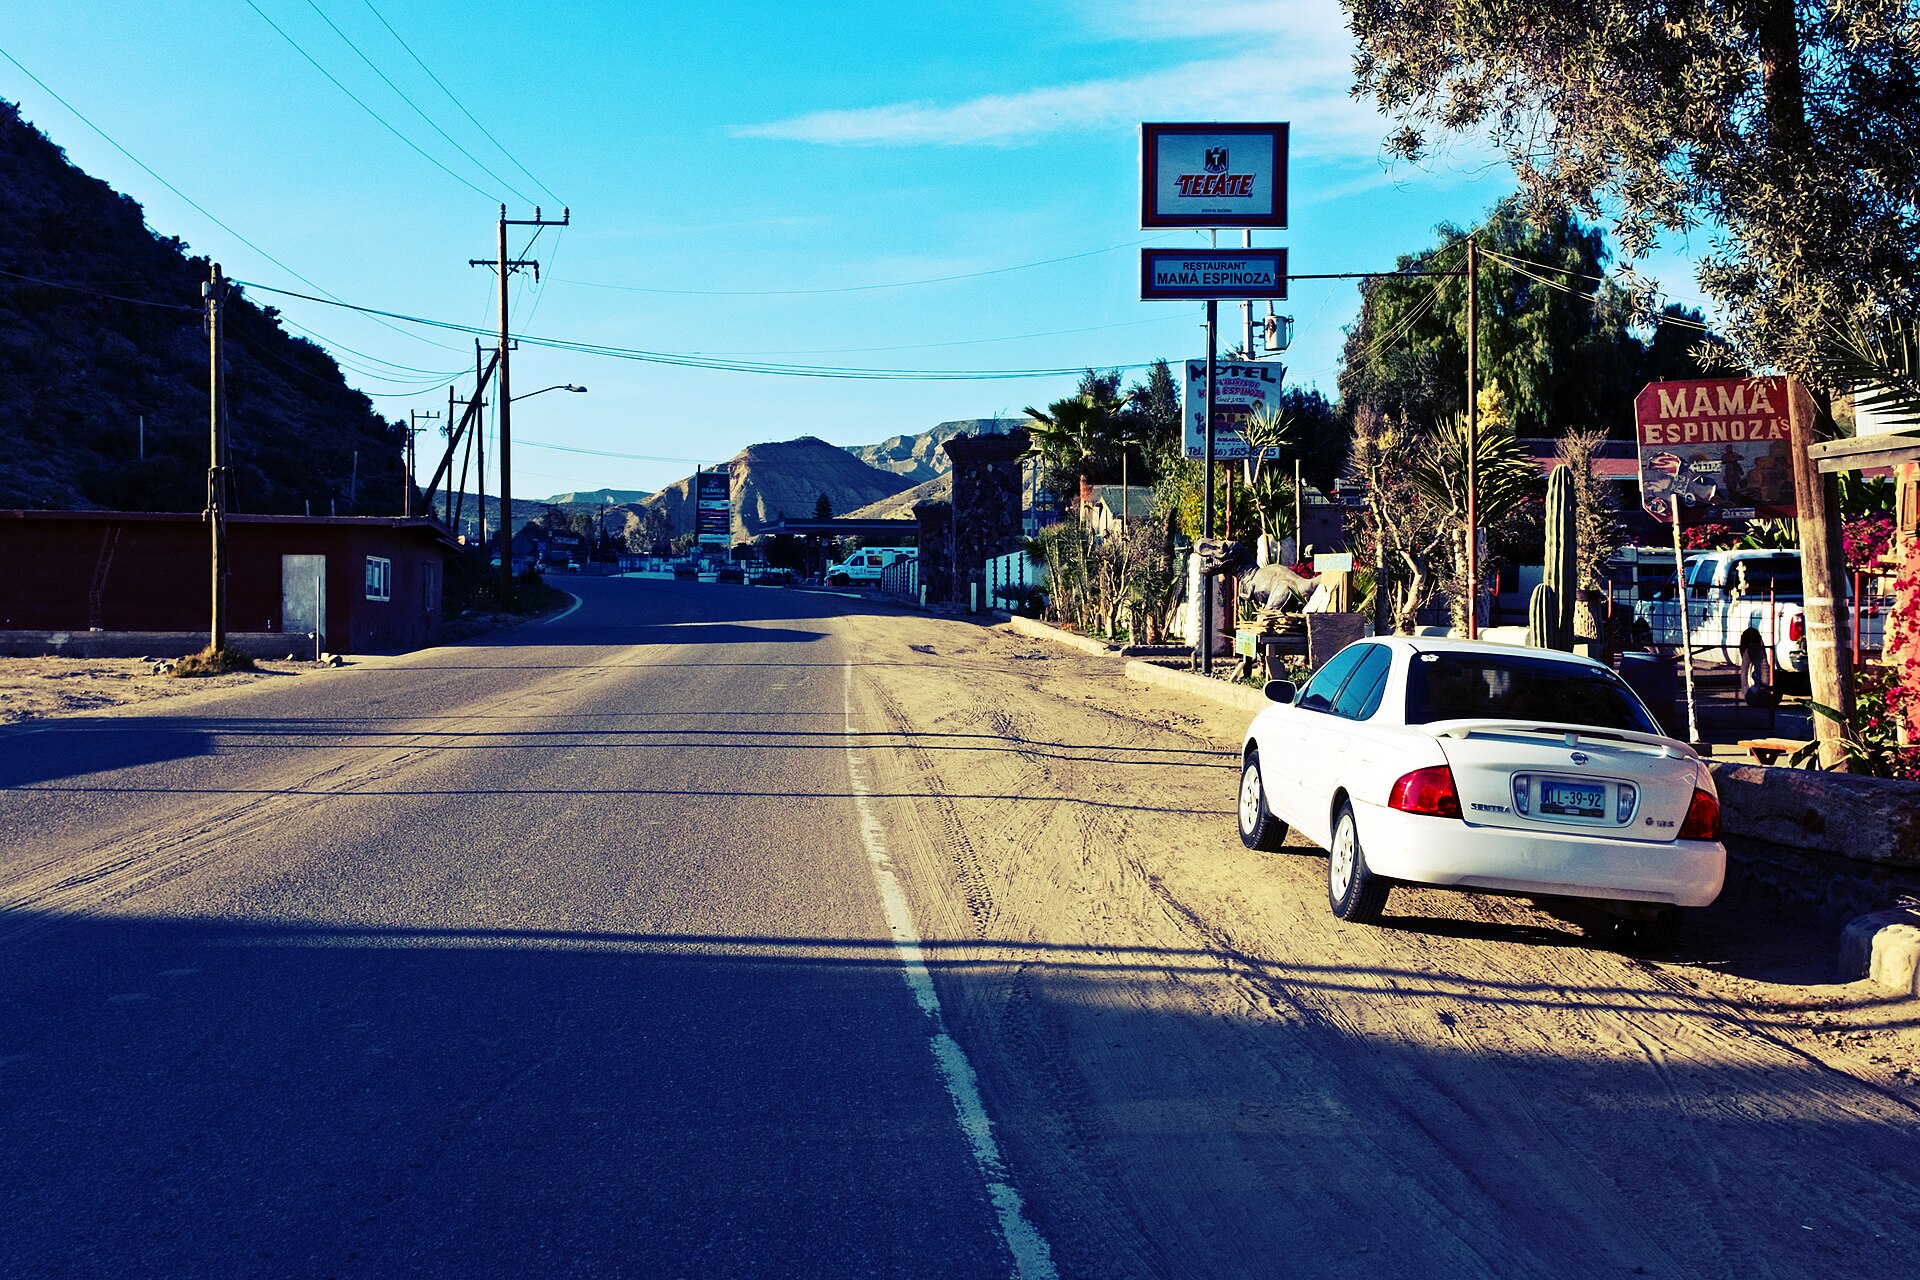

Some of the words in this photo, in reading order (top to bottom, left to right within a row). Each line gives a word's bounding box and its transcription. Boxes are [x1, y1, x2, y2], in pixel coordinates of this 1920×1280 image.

[1175, 172, 1256, 198] TECATE
[1182, 262, 1247, 270] RESTAURANT
[1157, 268, 1199, 284] MAMÁ
[1203, 272, 1271, 284] ESPINOZA
[1190, 364, 1276, 384] MOTEL
[1187, 446, 1204, 456] Tel.
[1544, 788, 1602, 808] ALL-39-92
[1470, 802, 1511, 814] SENTRA
